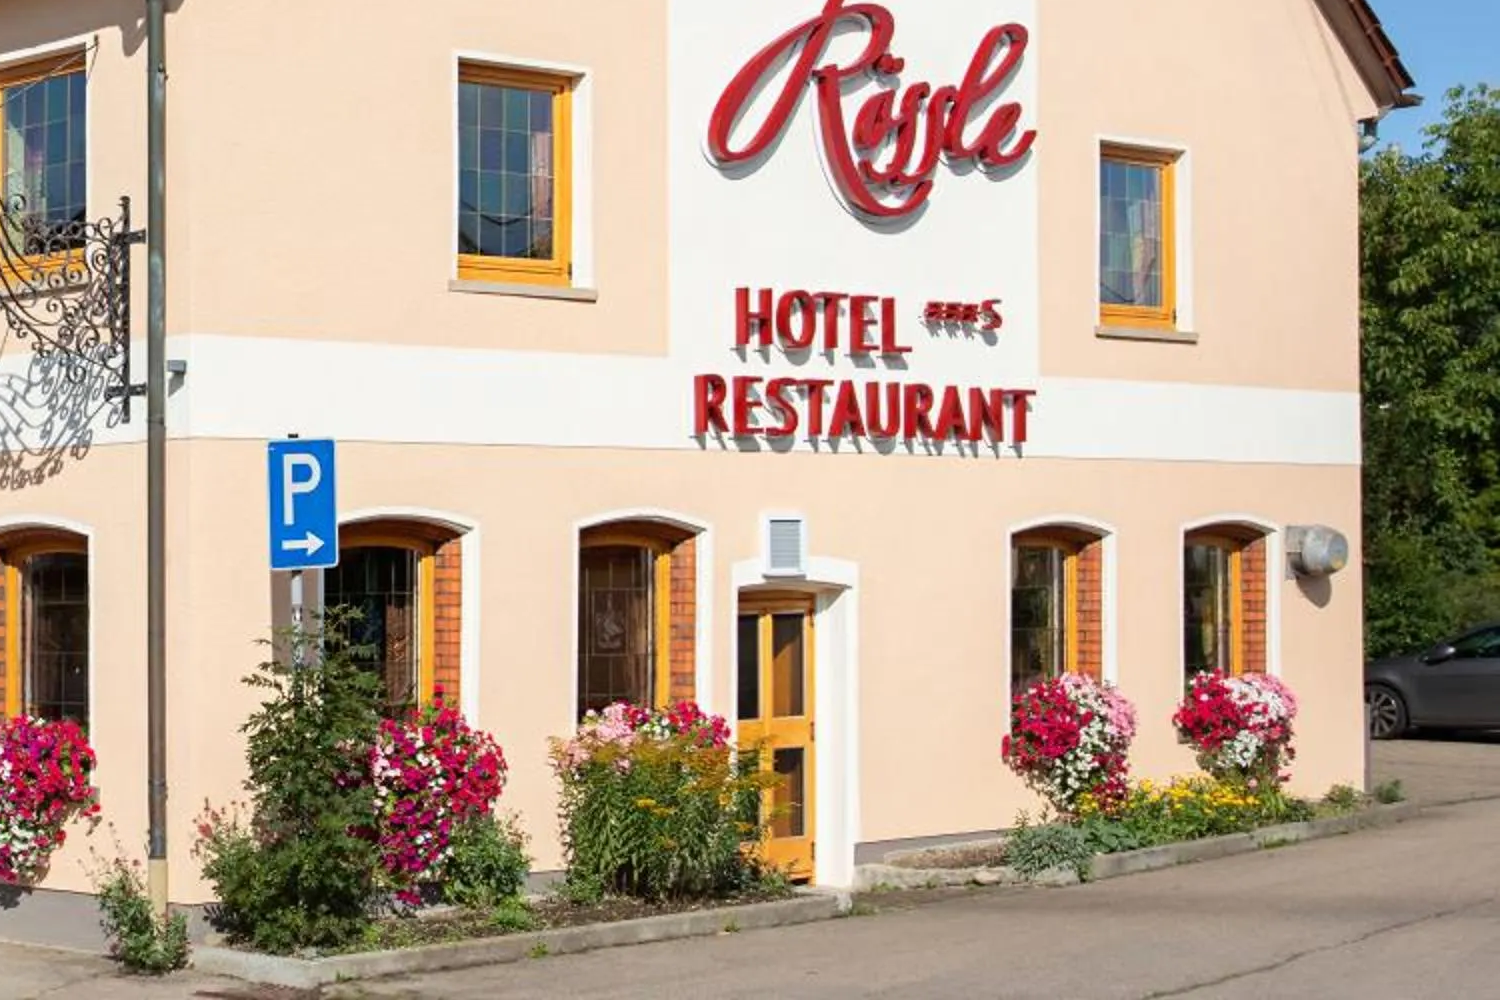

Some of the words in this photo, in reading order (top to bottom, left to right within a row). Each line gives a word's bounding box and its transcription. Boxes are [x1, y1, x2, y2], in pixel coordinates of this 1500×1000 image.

[735, 287, 912, 353] HOTEL
[694, 374, 1036, 442] RESTAURANT
[283, 453, 321, 525] P
